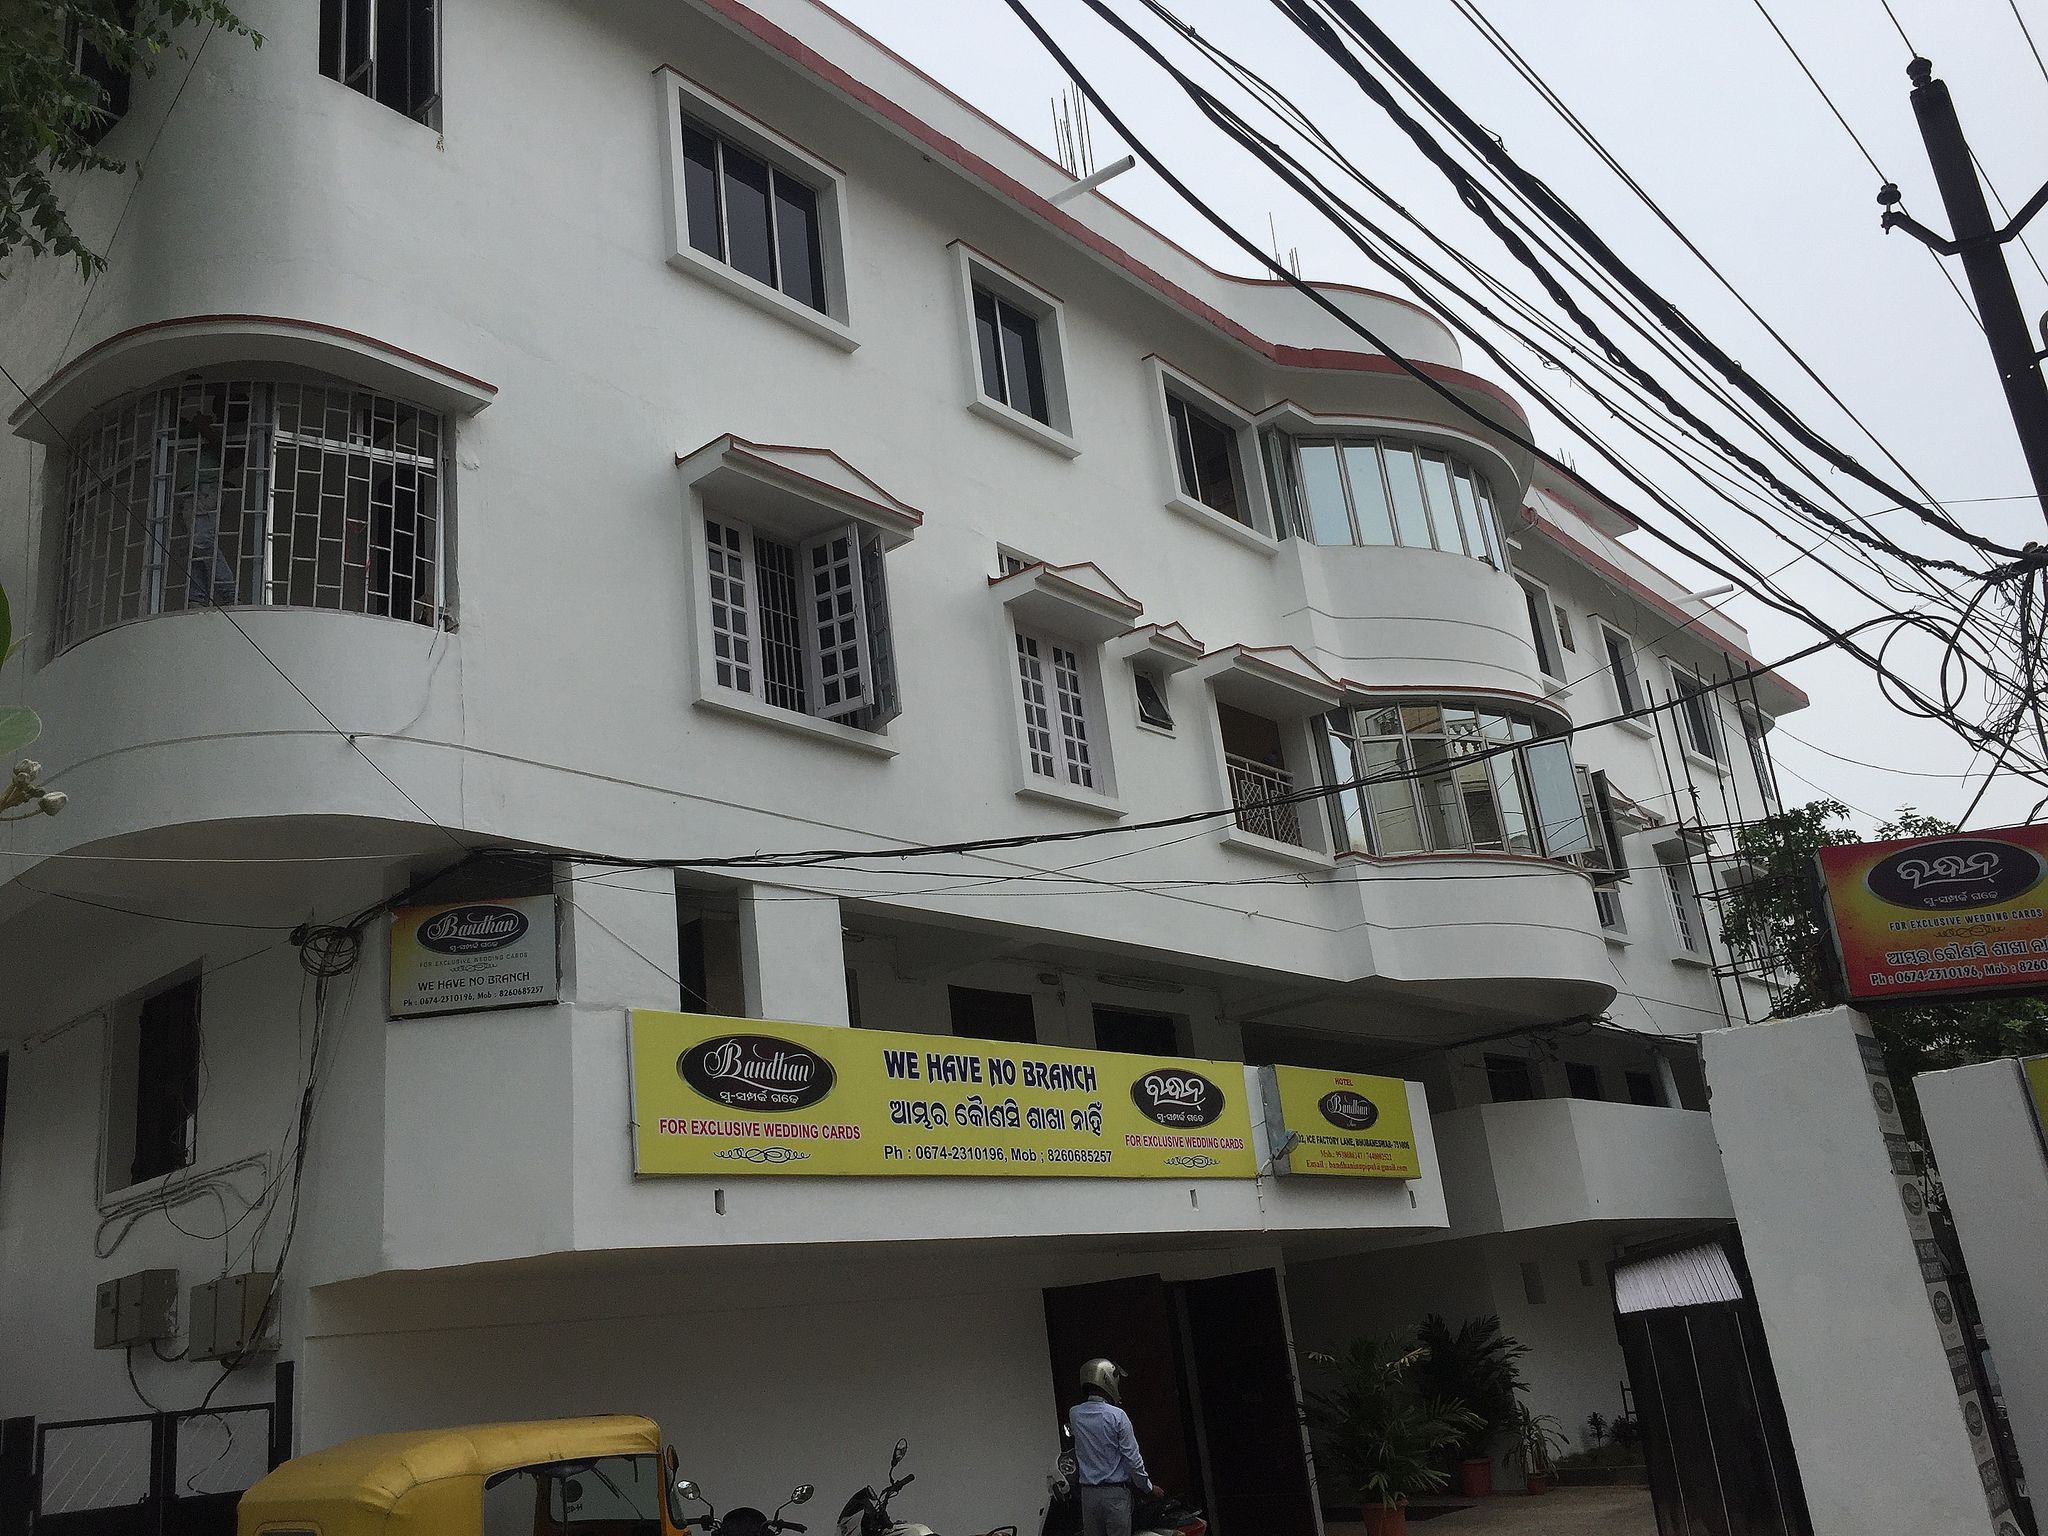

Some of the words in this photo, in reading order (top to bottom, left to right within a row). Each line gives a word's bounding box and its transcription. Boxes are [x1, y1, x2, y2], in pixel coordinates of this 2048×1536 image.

[427, 913, 520, 941] Bandhan
[1889, 922, 1907, 932] FOR
[1910, 916, 1961, 929] EXCLUSIVE
[1965, 911, 2008, 924] WEDDING
[2012, 908, 2043, 919] CARDS
[435, 958, 470, 967] EXCLUSIVE
[474, 954, 504, 964] WEDDING
[506, 952, 528, 960] CARDS
[418, 981, 434, 991] WE
[438, 978, 465, 990] HAVE
[469, 976, 485, 986] NO
[488, 971, 530, 985] BRANCH
[1871, 973, 1886, 986] Ph
[1896, 965, 1983, 983] 0674-2310196,
[1985, 963, 2008, 976] Mob
[404, 999, 412, 1007] Ph
[477, 991, 492, 999] Mob
[703, 1039, 815, 1091] Bandhan
[884, 1050, 919, 1079] WE
[927, 1054, 982, 1084] HAVE
[988, 1057, 1016, 1087] NO
[1022, 1061, 1098, 1092] BRANCH
[1335, 1077, 1353, 1086] HOTEL
[1327, 1093, 1369, 1121] Bandhan
[660, 1119, 687, 1135] FOR
[691, 1120, 760, 1137] EXCLUSIVE
[764, 1123, 818, 1139] WEDDING
[822, 1125, 861, 1140] CARDS
[1125, 1135, 1141, 1147] FOR
[1143, 1136, 1184, 1148] EXCLUSIVE
[1185, 1137, 1218, 1149] WEDDING
[1220, 1138, 1244, 1150] CARDS
[1316, 1135, 1339, 1145] FACTORY
[884, 1146, 902, 1160] Ph
[915, 1146, 1008, 1163] 0674-2310196,
[1012, 1148, 1037, 1162] Mob
[1047, 1149, 1112, 1163] 8260685257
